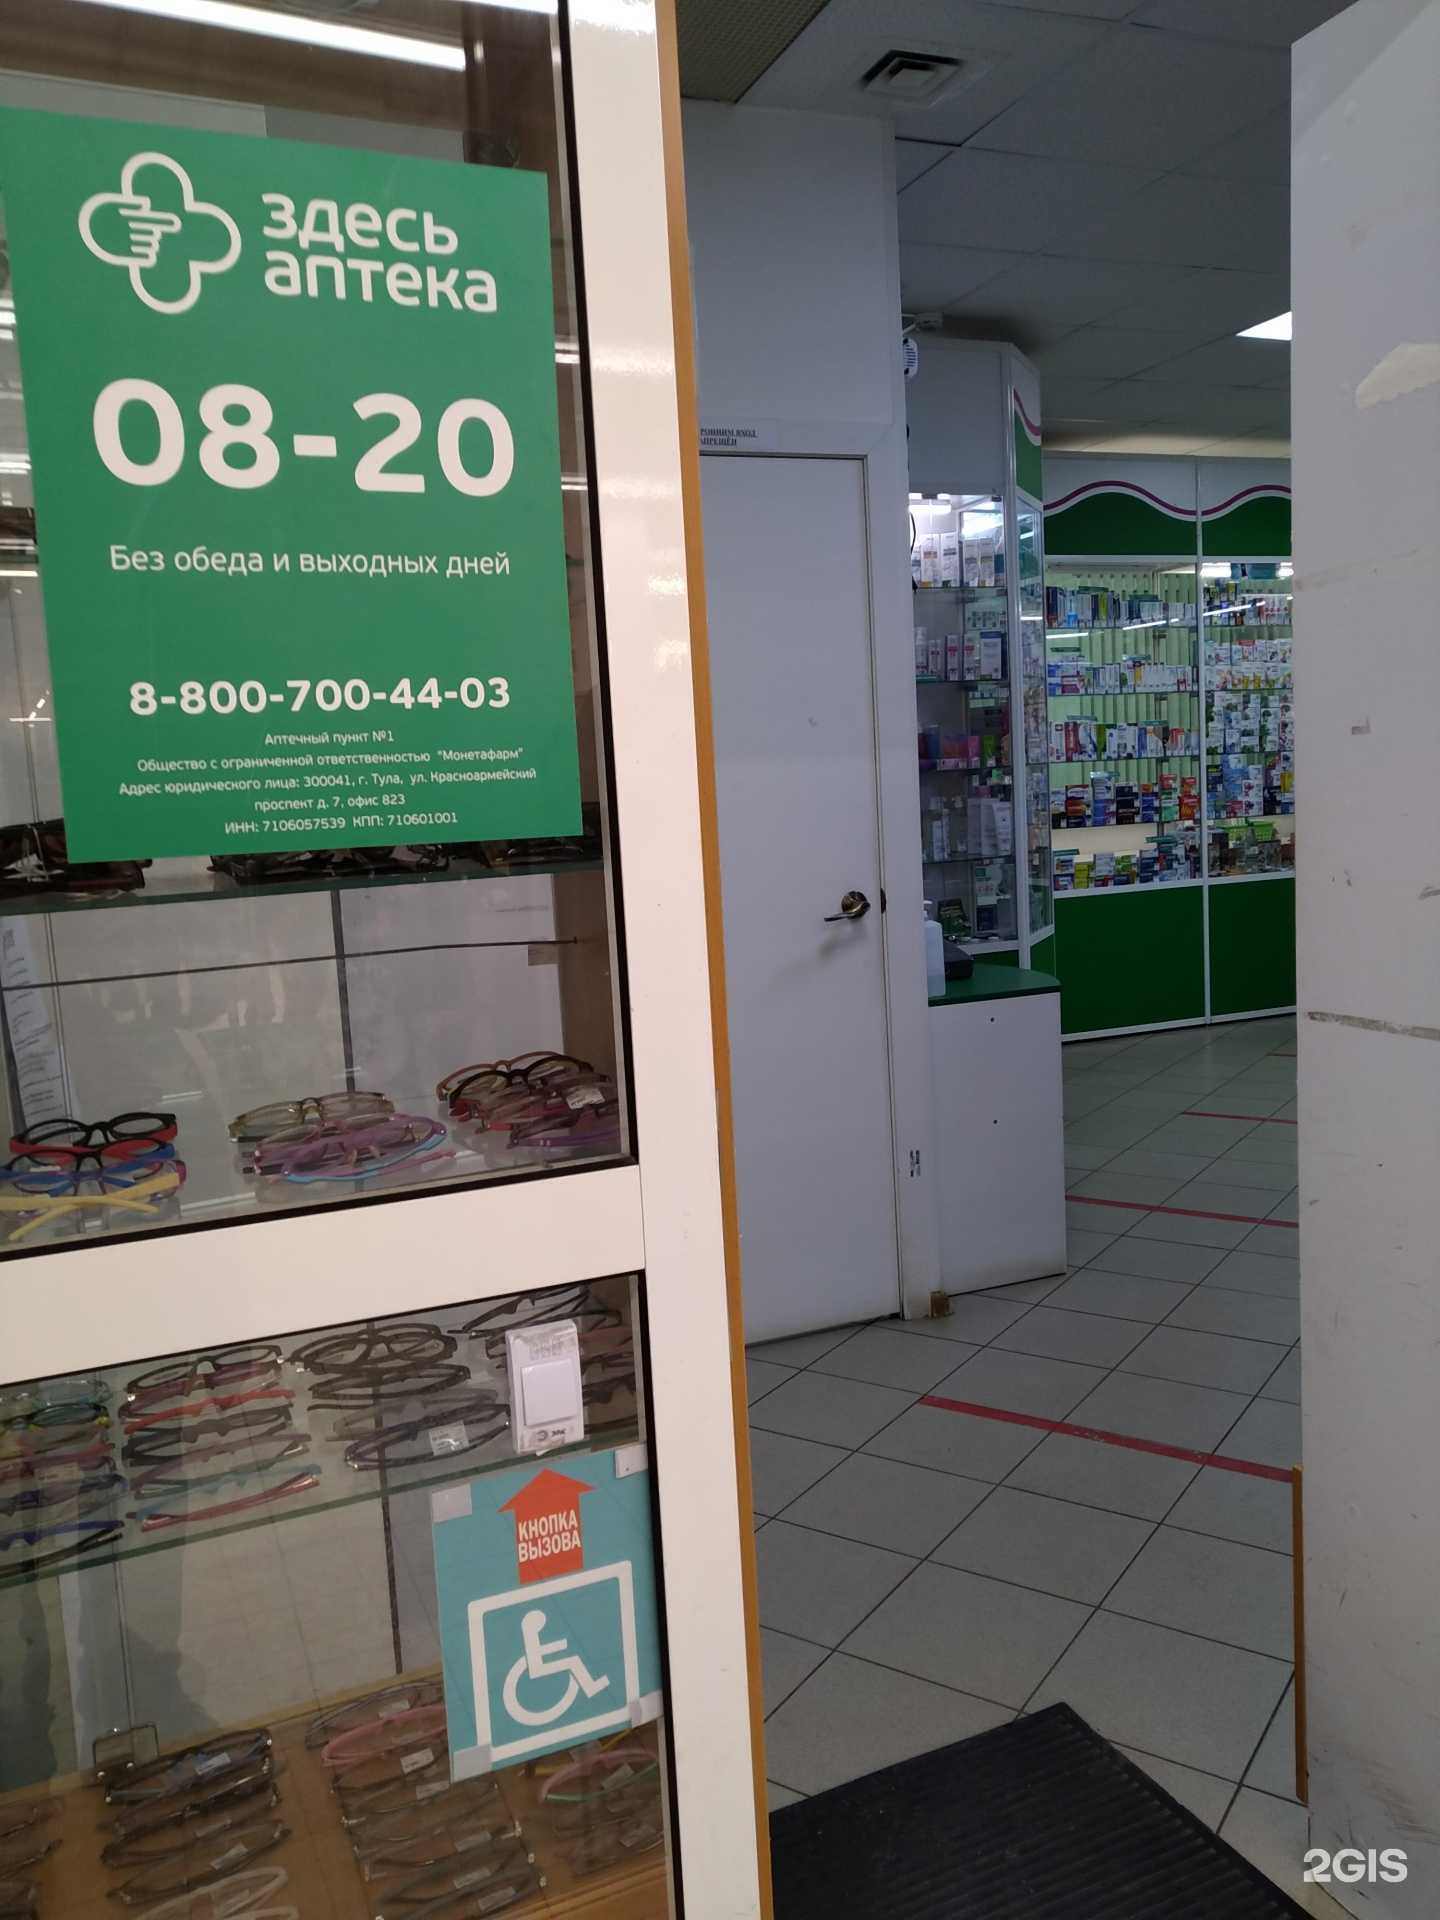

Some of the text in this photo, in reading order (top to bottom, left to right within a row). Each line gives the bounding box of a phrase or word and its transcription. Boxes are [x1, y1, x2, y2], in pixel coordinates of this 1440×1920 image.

[262, 193, 458, 255] здесь
[265, 250, 497, 312] аптека
[94, 379, 514, 496] 08-20
[111, 545, 509, 578] Без обеда и выходных дней
[131, 677, 509, 715] 8-800-700-44-03
[265, 730, 393, 745] Аптечный пункт №1
[138, 747, 523, 772] Общество с ограниченной ответственностью "Монетафарм"
[120, 768, 536, 796] Адрес юридического лица: 300041, г. Тула, ул. Красноармейский
[255, 794, 405, 812] проспект д. 7, офис 823
[225, 813, 457, 833] ИНН: 7106057539 КПП: 710601001
[518, 1509, 578, 1542] КНОПКА
[518, 1532, 582, 1563] ВЫЗОВА
